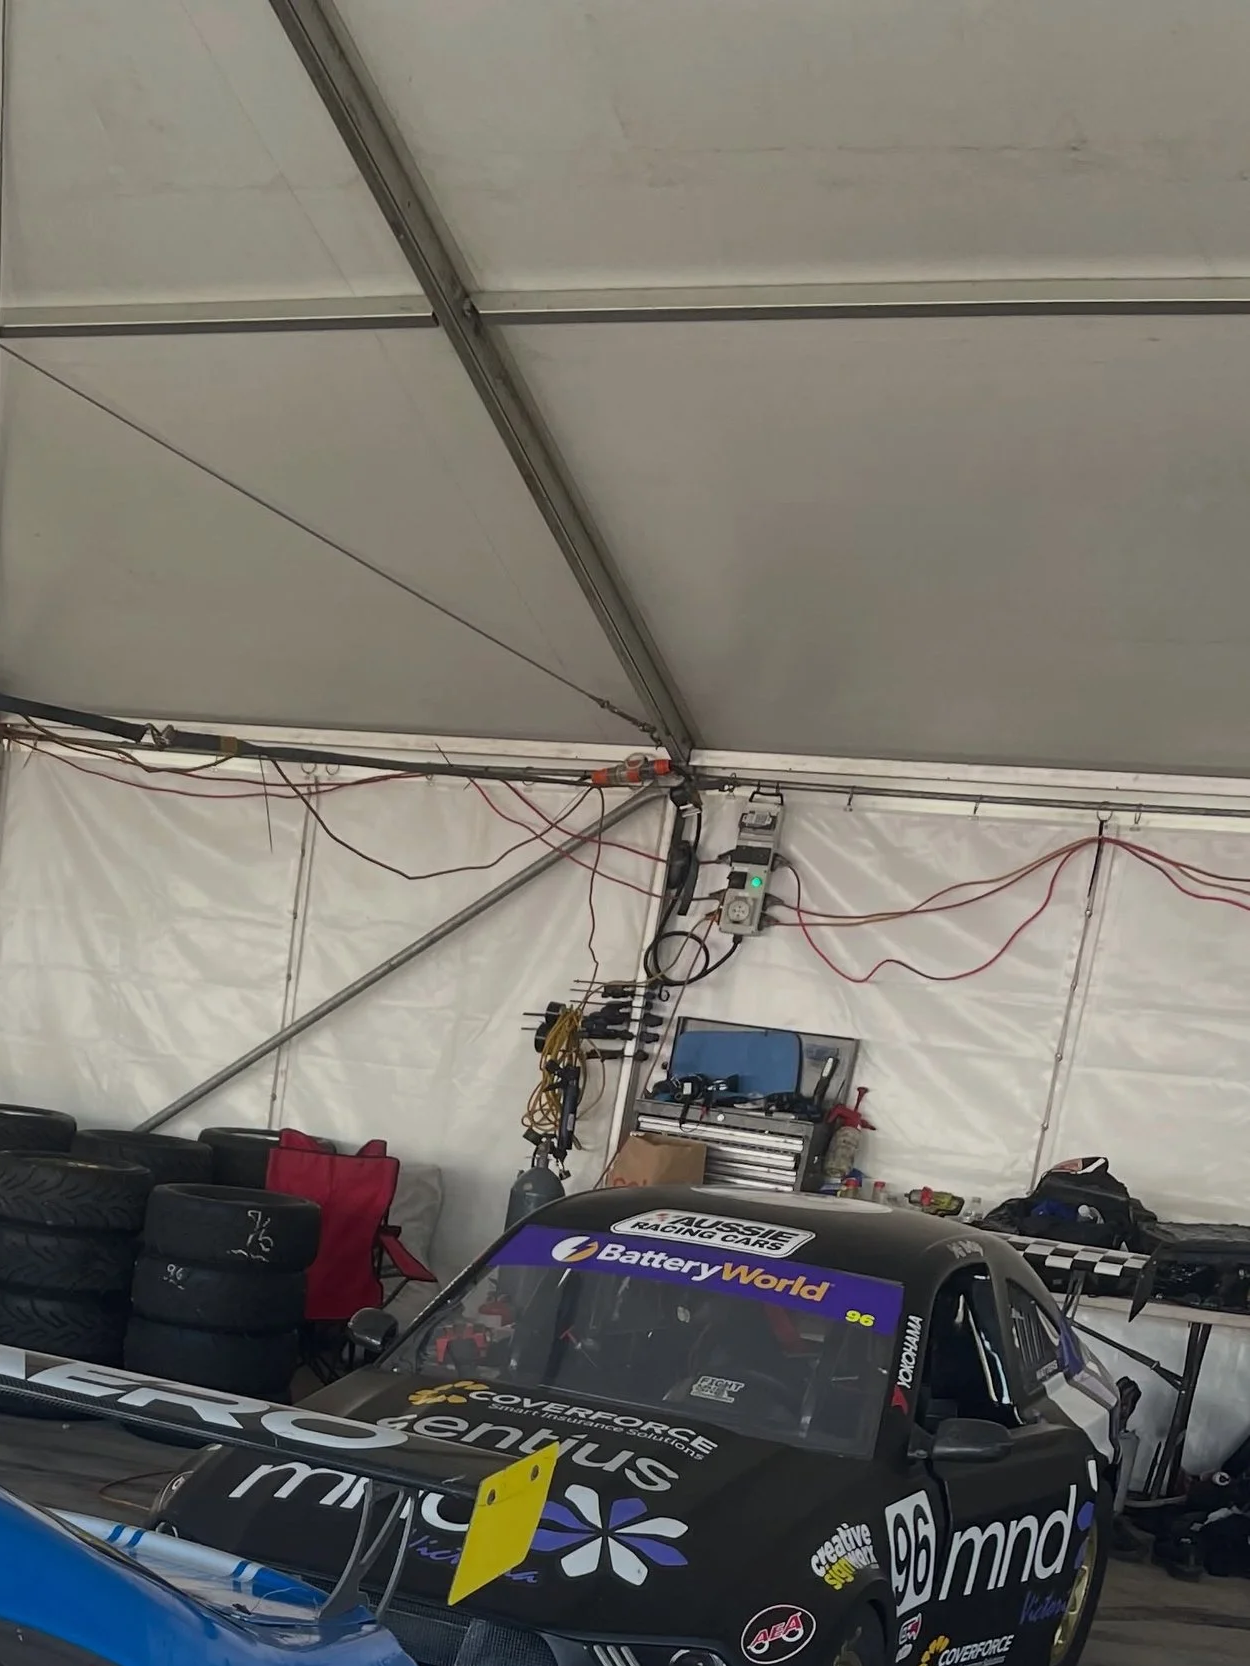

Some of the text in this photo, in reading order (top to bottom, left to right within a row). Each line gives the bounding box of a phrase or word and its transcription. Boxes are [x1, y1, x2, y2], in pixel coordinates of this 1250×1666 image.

[631, 1221, 785, 1253] RACING CARS
[667, 1214, 800, 1244] AUSSIE
[845, 1310, 875, 1327] 96
[896, 1315, 924, 1389] YOKOHAMA
[468, 1390, 719, 1455] COVERFORCE
[488, 1402, 704, 1461] Smart Insurance Solutions
[810, 1522, 872, 1578] creative
[892, 1504, 932, 1607] 96
[938, 1484, 1077, 1601] mnd
[747, 1611, 803, 1647] AEA
[938, 1634, 1014, 1666] COVERFORCE
